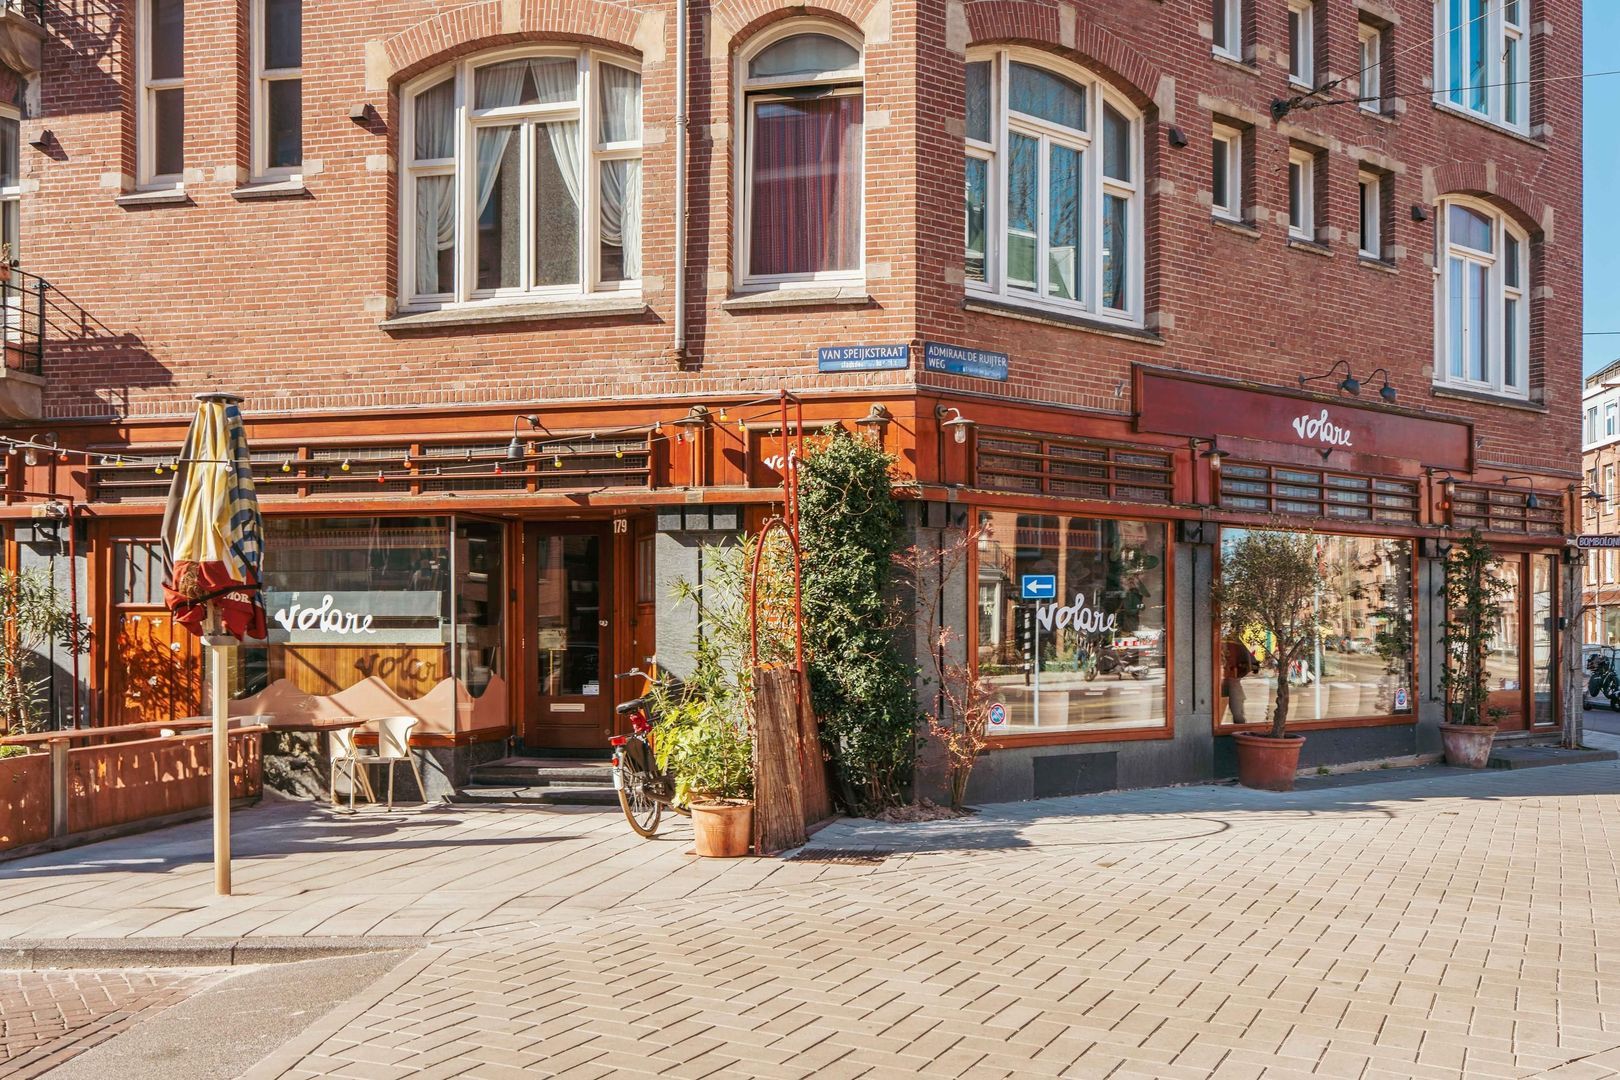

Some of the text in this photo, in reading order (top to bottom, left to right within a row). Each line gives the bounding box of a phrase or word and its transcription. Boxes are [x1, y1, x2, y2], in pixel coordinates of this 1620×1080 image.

[821, 346, 905, 361] VAN SPEIJKSTRAAT
[928, 346, 1007, 368] ADMIRAAL DE RUIJTER
[928, 357, 946, 369] WEG
[1292, 409, 1353, 446] volare
[612, 519, 628, 534] 179
[222, 590, 252, 604] MOR
[274, 594, 377, 634] volare
[1036, 593, 1118, 633] volare
